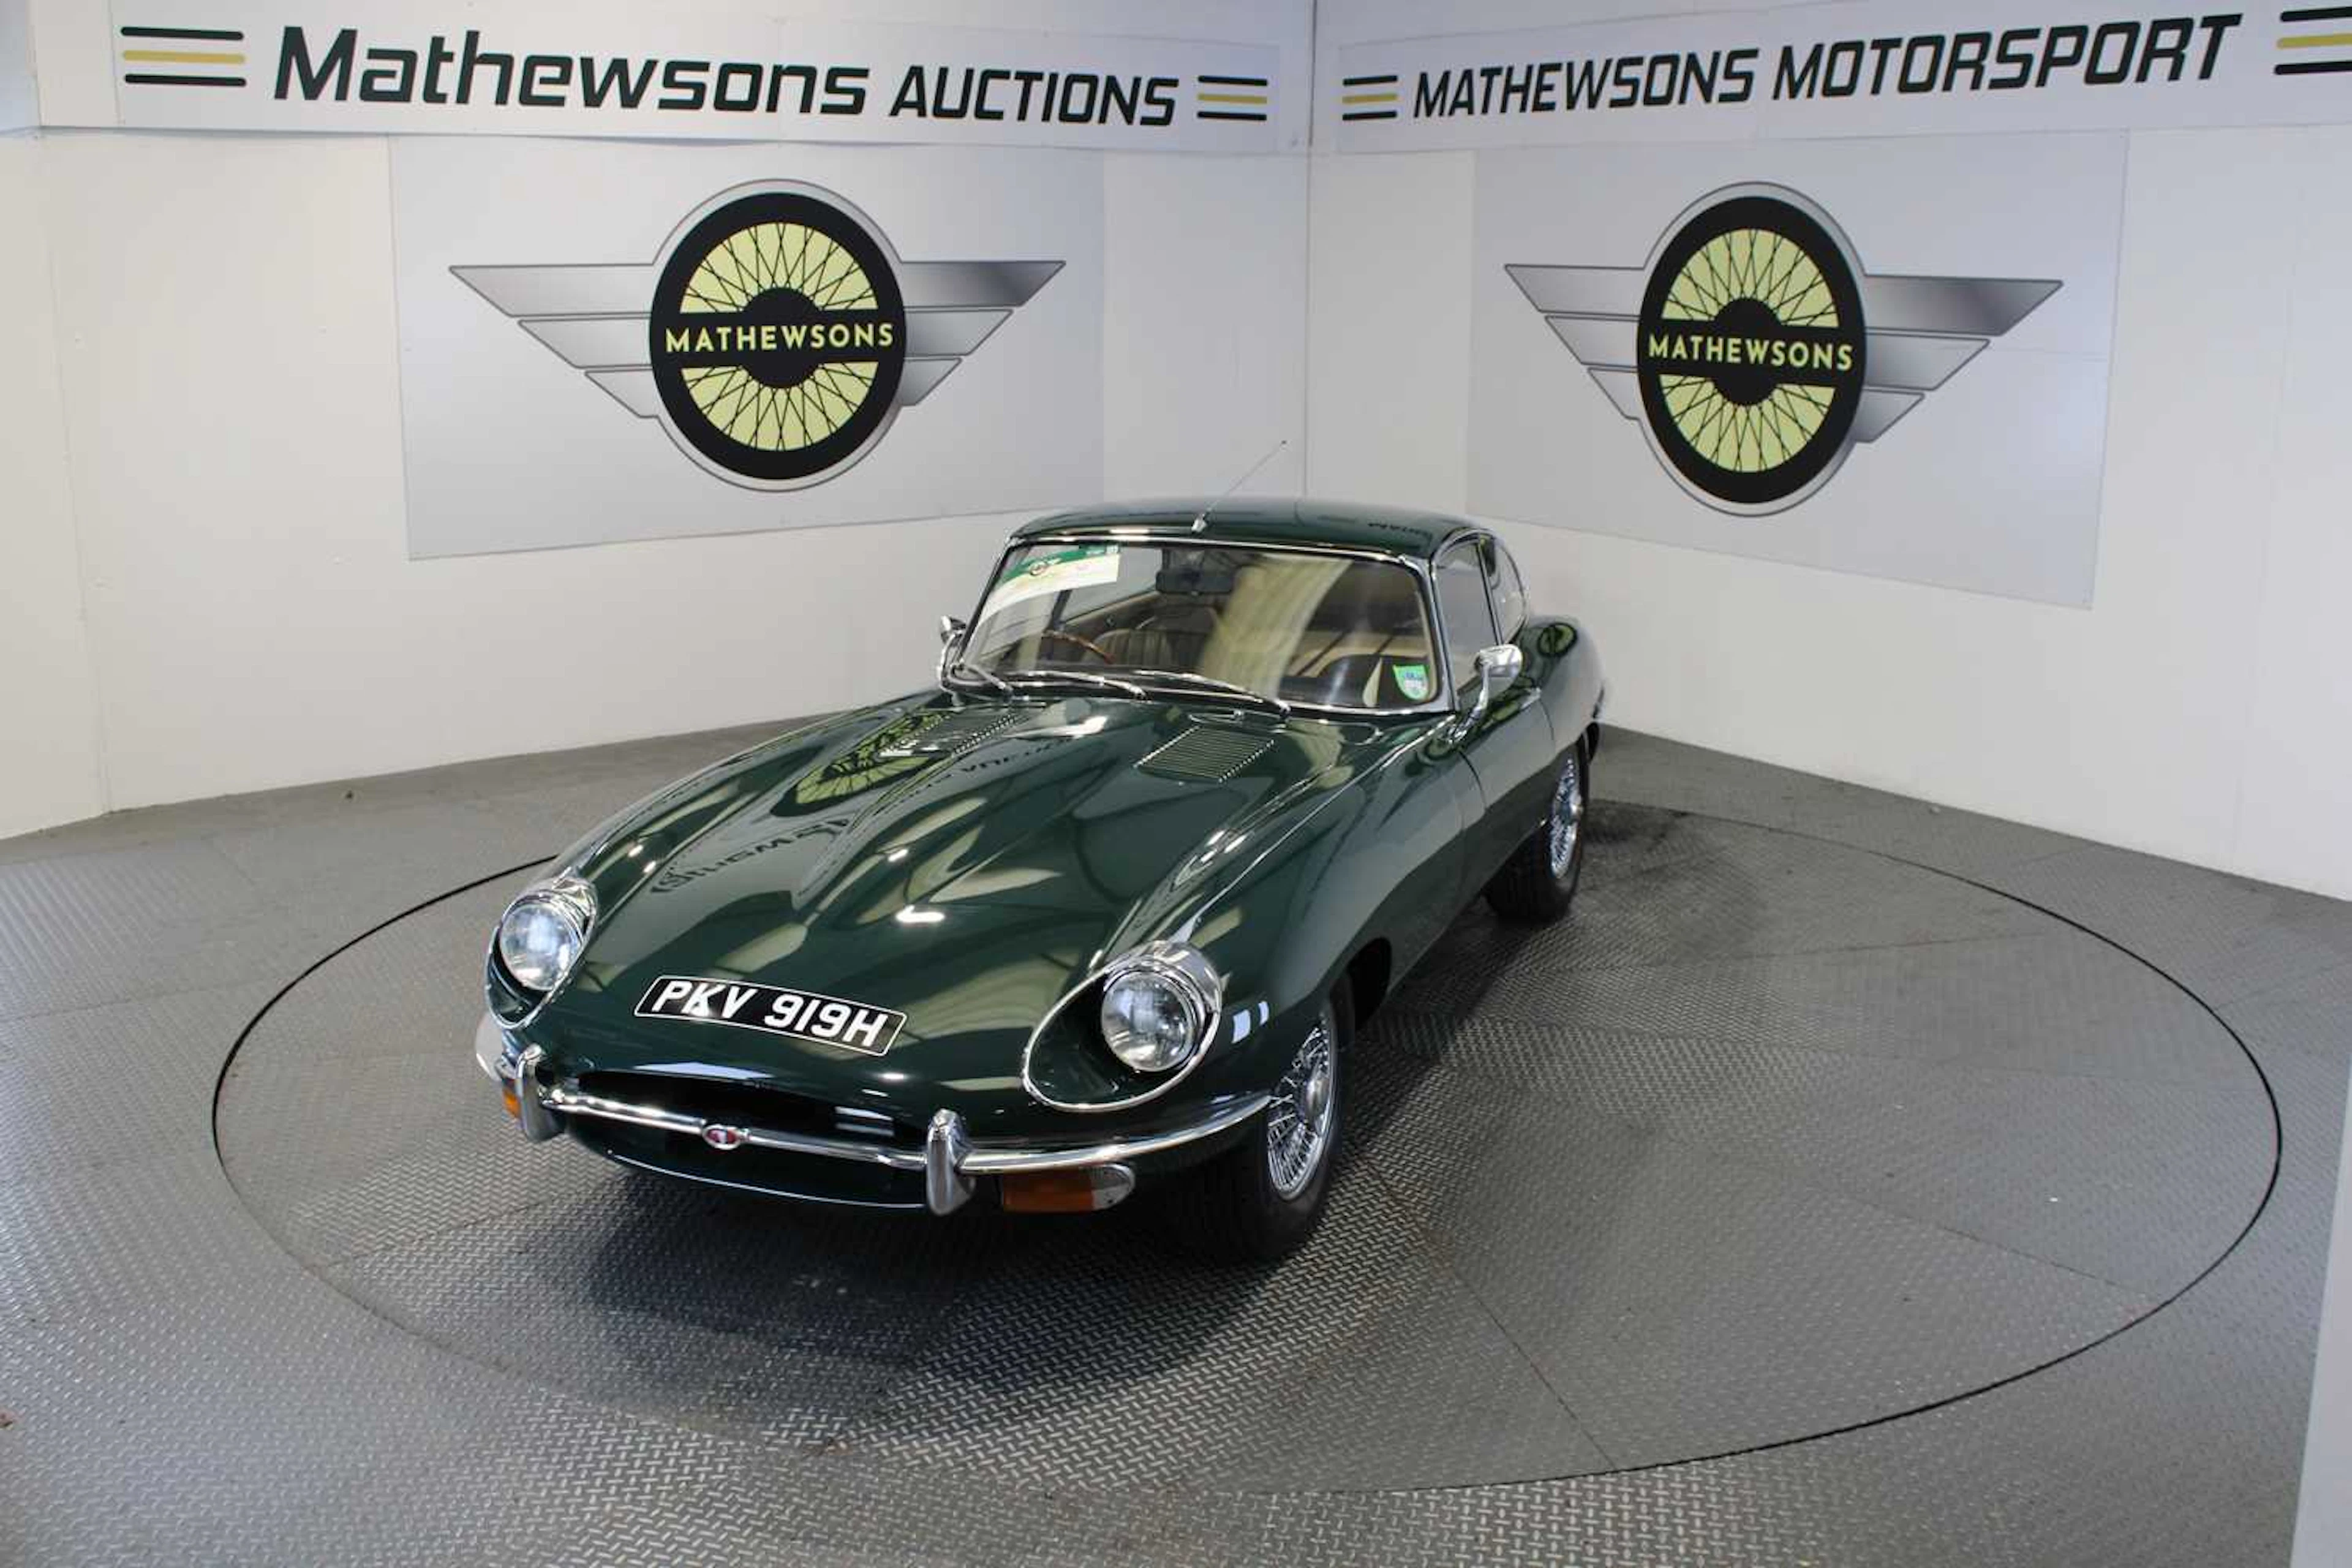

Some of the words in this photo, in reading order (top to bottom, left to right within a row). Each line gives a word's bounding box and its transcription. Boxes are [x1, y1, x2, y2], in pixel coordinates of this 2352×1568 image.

[274, 26, 870, 115] Mathewsons
[889, 65, 1180, 127] AUCTIONS
[1413, 48, 1759, 118] MATHEWSONS
[1773, 13, 2243, 100] MOTORSPORT
[665, 322, 894, 353] MATHEWSONS
[1648, 334, 1853, 371] MATHEWSONS
[651, 979, 758, 1019] PKV
[764, 993, 889, 1047] 919H
